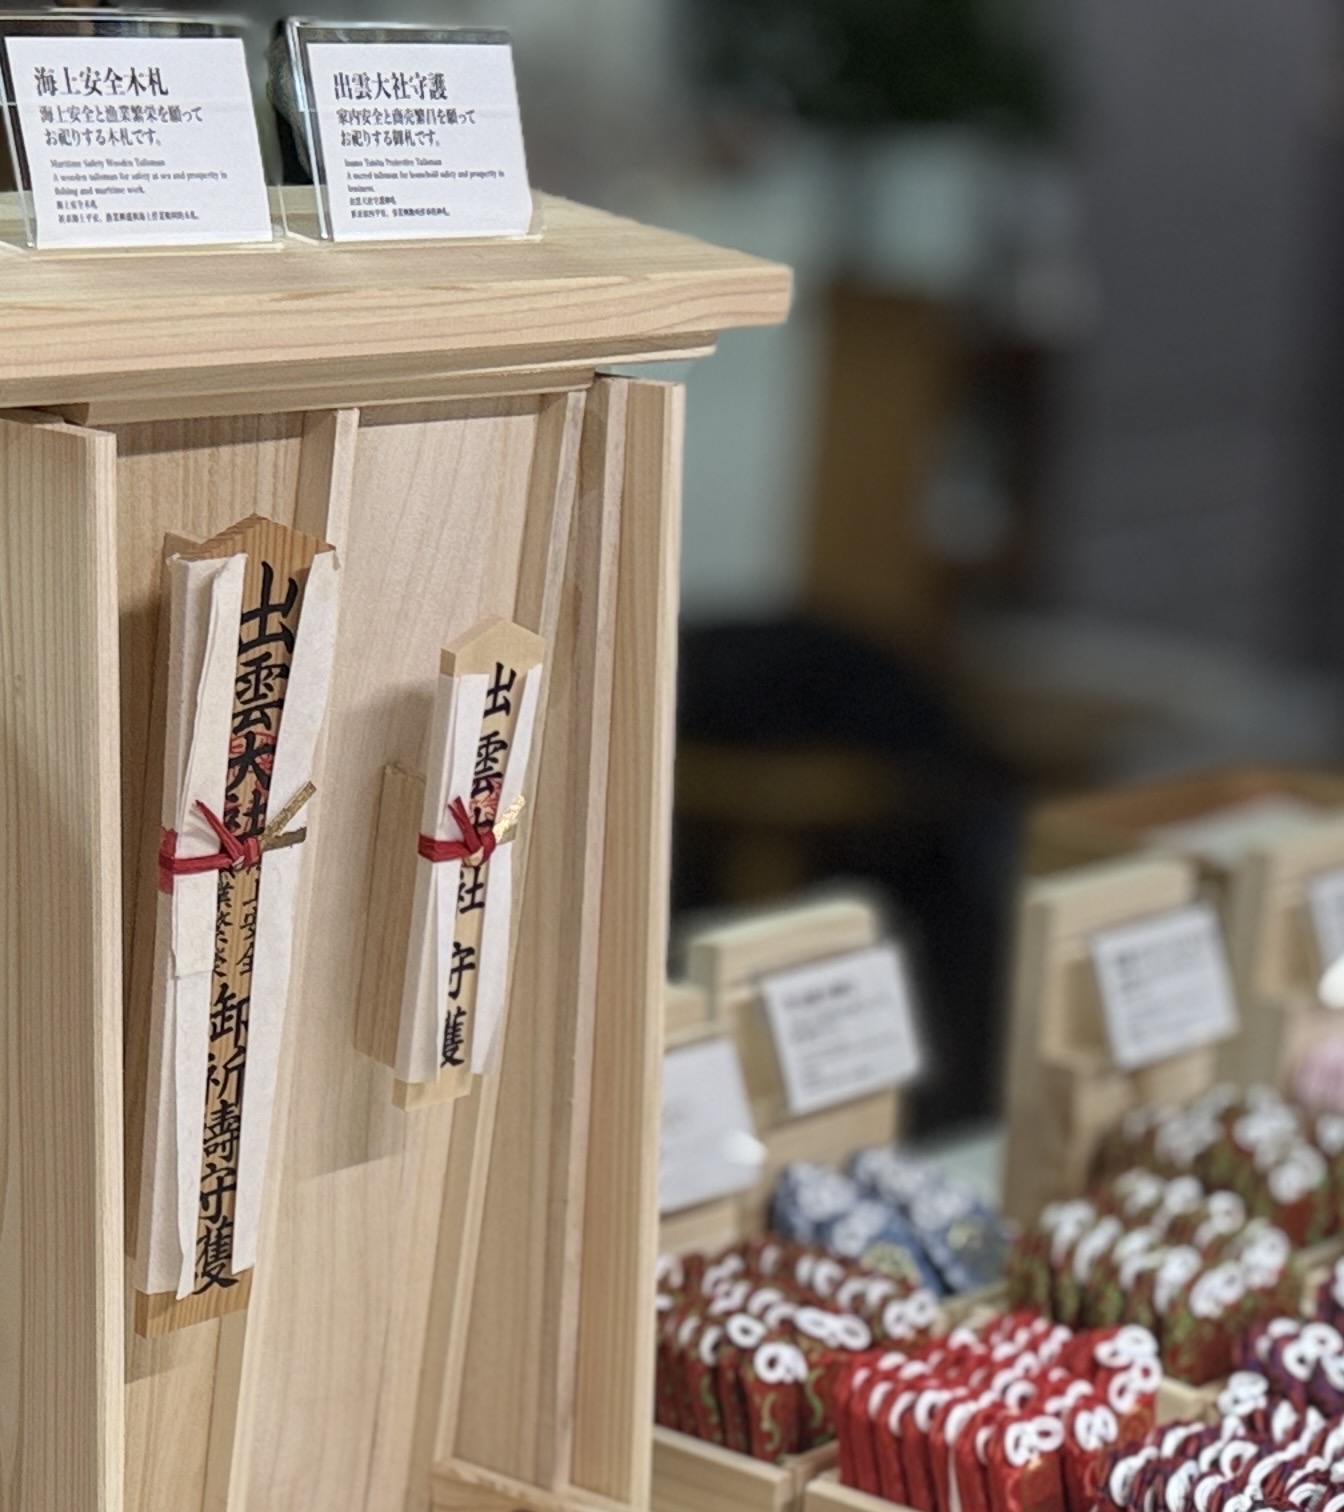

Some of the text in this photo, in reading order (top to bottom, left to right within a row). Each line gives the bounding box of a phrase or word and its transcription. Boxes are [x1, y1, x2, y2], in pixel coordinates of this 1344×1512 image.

[34, 66, 169, 97] 海上安全木札
[333, 72, 448, 100] 出雲大社守護
